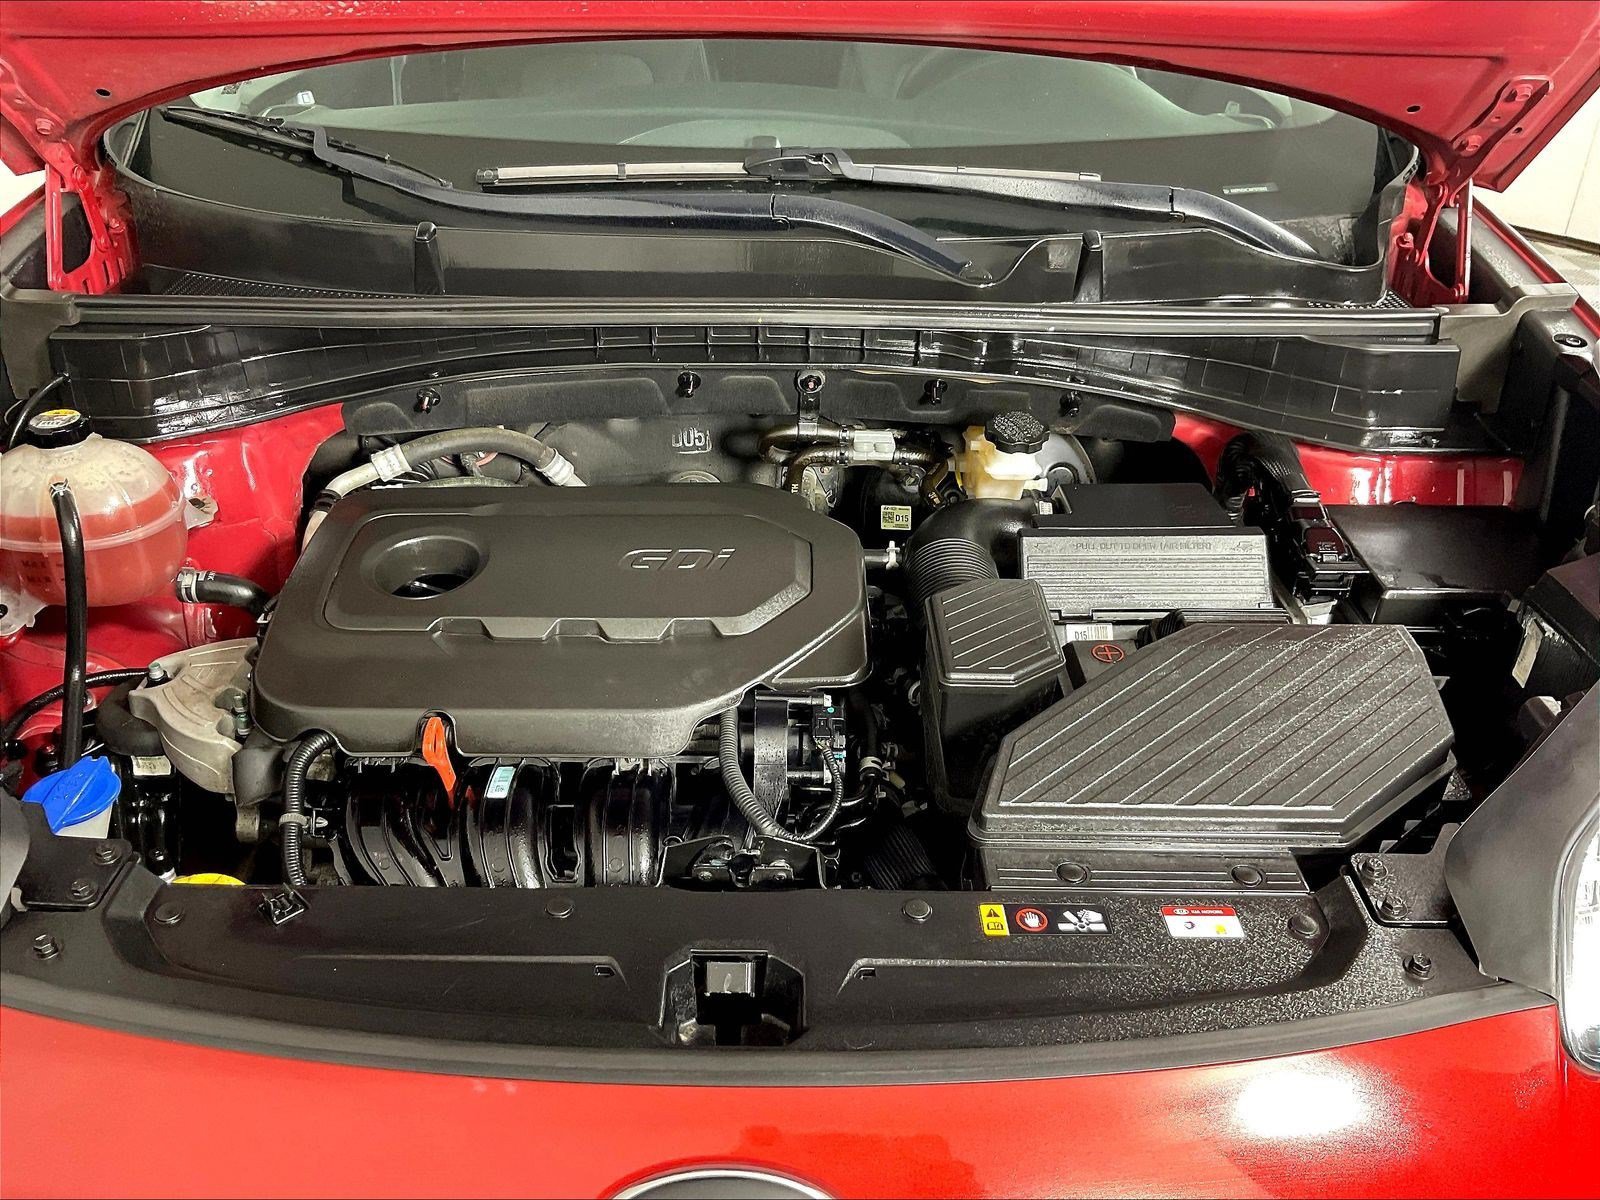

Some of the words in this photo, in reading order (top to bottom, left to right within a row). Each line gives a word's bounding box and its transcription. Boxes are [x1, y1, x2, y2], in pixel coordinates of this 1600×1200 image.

[895, 514, 909, 522] D15
[1099, 542, 1117, 550] OUT
[1074, 630, 1088, 640] D15
